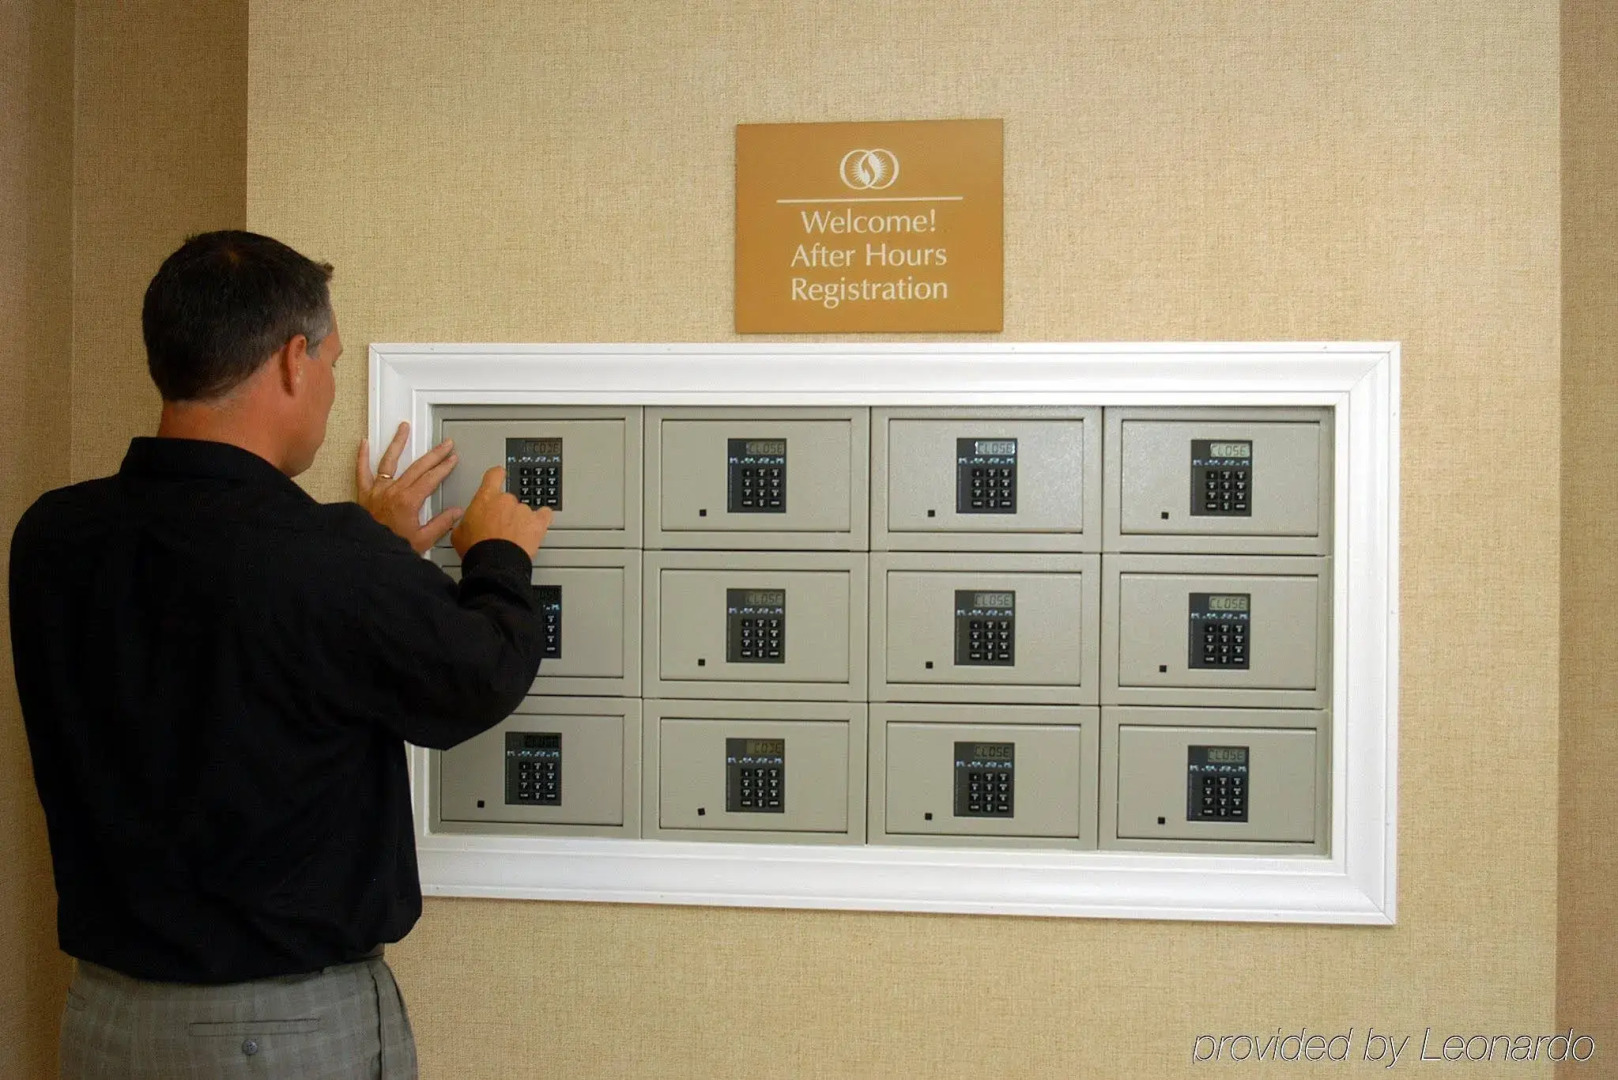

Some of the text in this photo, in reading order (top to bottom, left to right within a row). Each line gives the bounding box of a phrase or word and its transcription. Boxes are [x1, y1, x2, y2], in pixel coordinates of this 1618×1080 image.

[801, 208, 936, 234] Welcome!
[790, 242, 947, 267] After Hours
[791, 276, 948, 309] Registration
[1210, 598, 1246, 609] CLOSE
[975, 746, 1010, 758] CLOSE
